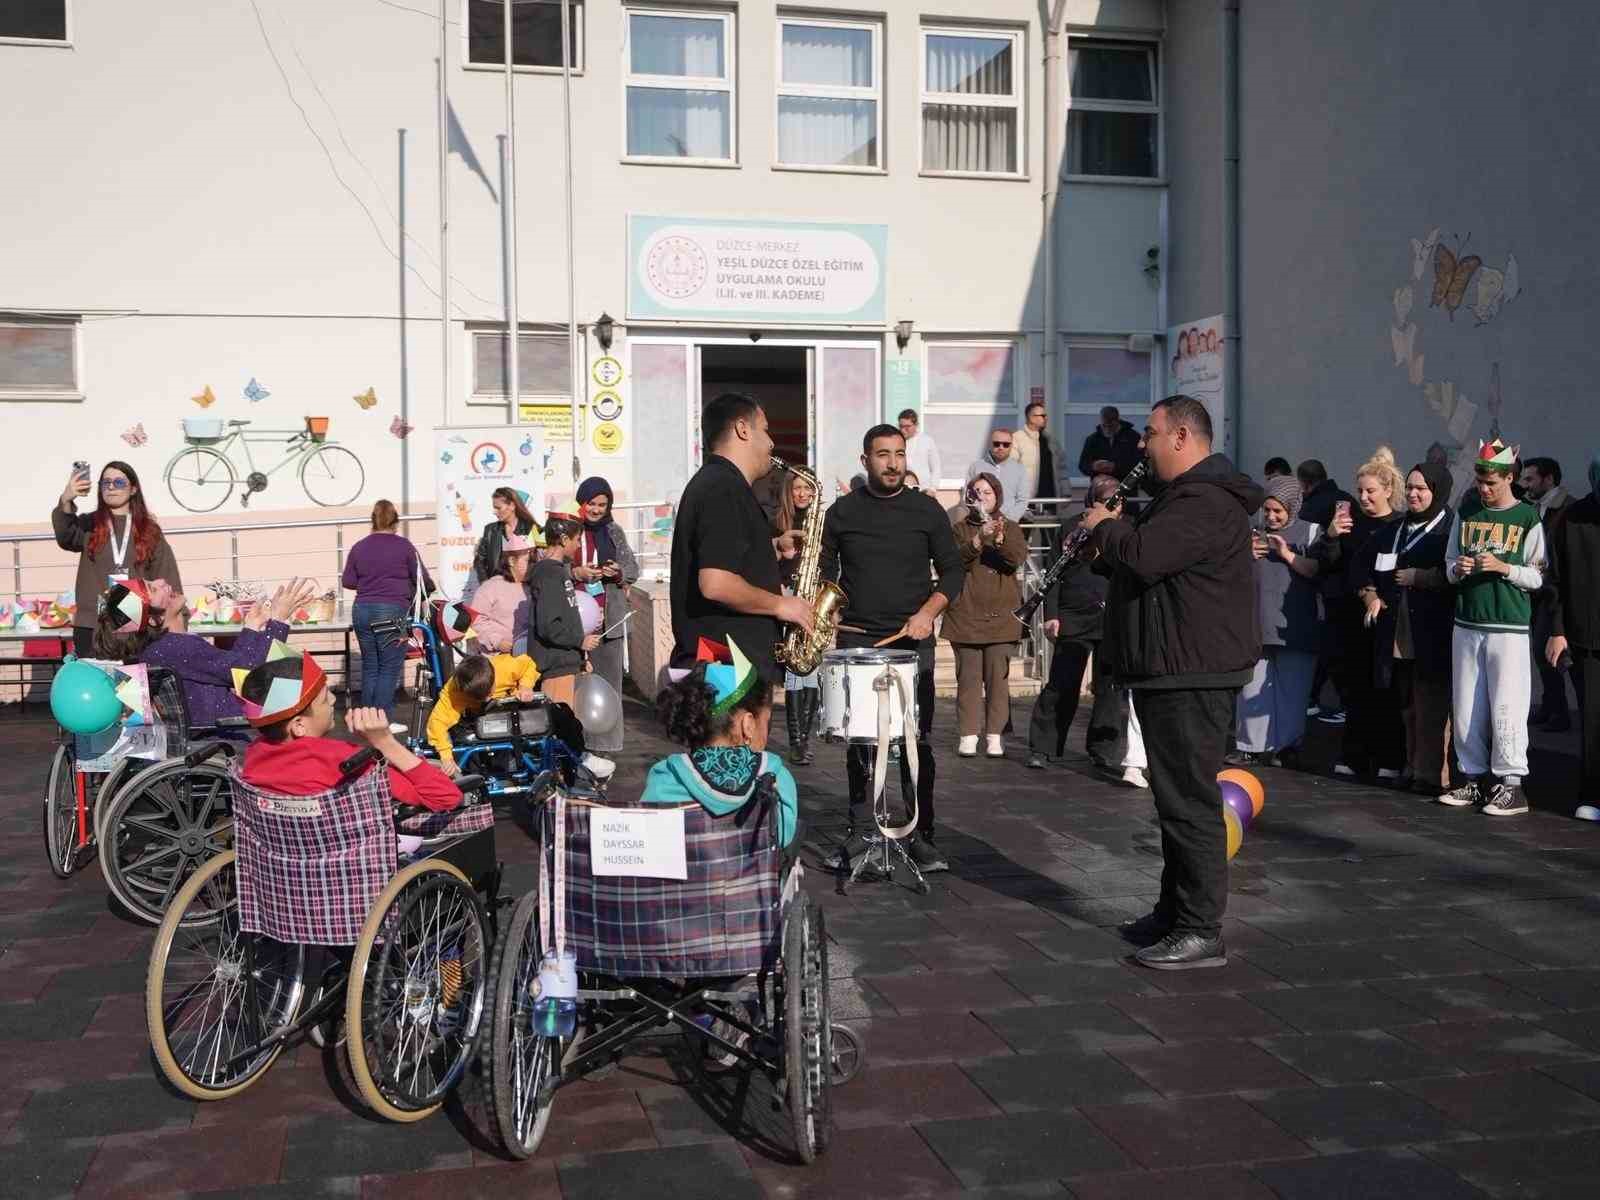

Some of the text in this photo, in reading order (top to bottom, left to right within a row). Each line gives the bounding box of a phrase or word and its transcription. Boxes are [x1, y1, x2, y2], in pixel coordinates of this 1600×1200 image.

[717, 256, 864, 272] YEŞİL DÜZCE ÖZEL EĞİTİM
[717, 273, 826, 287] UYGULAMA OKULU
[739, 291, 753, 300] ve
[1462, 521, 1524, 553] UTAH
[603, 839, 645, 849] DAYSSAR
[604, 855, 644, 865] HUSSEIN
